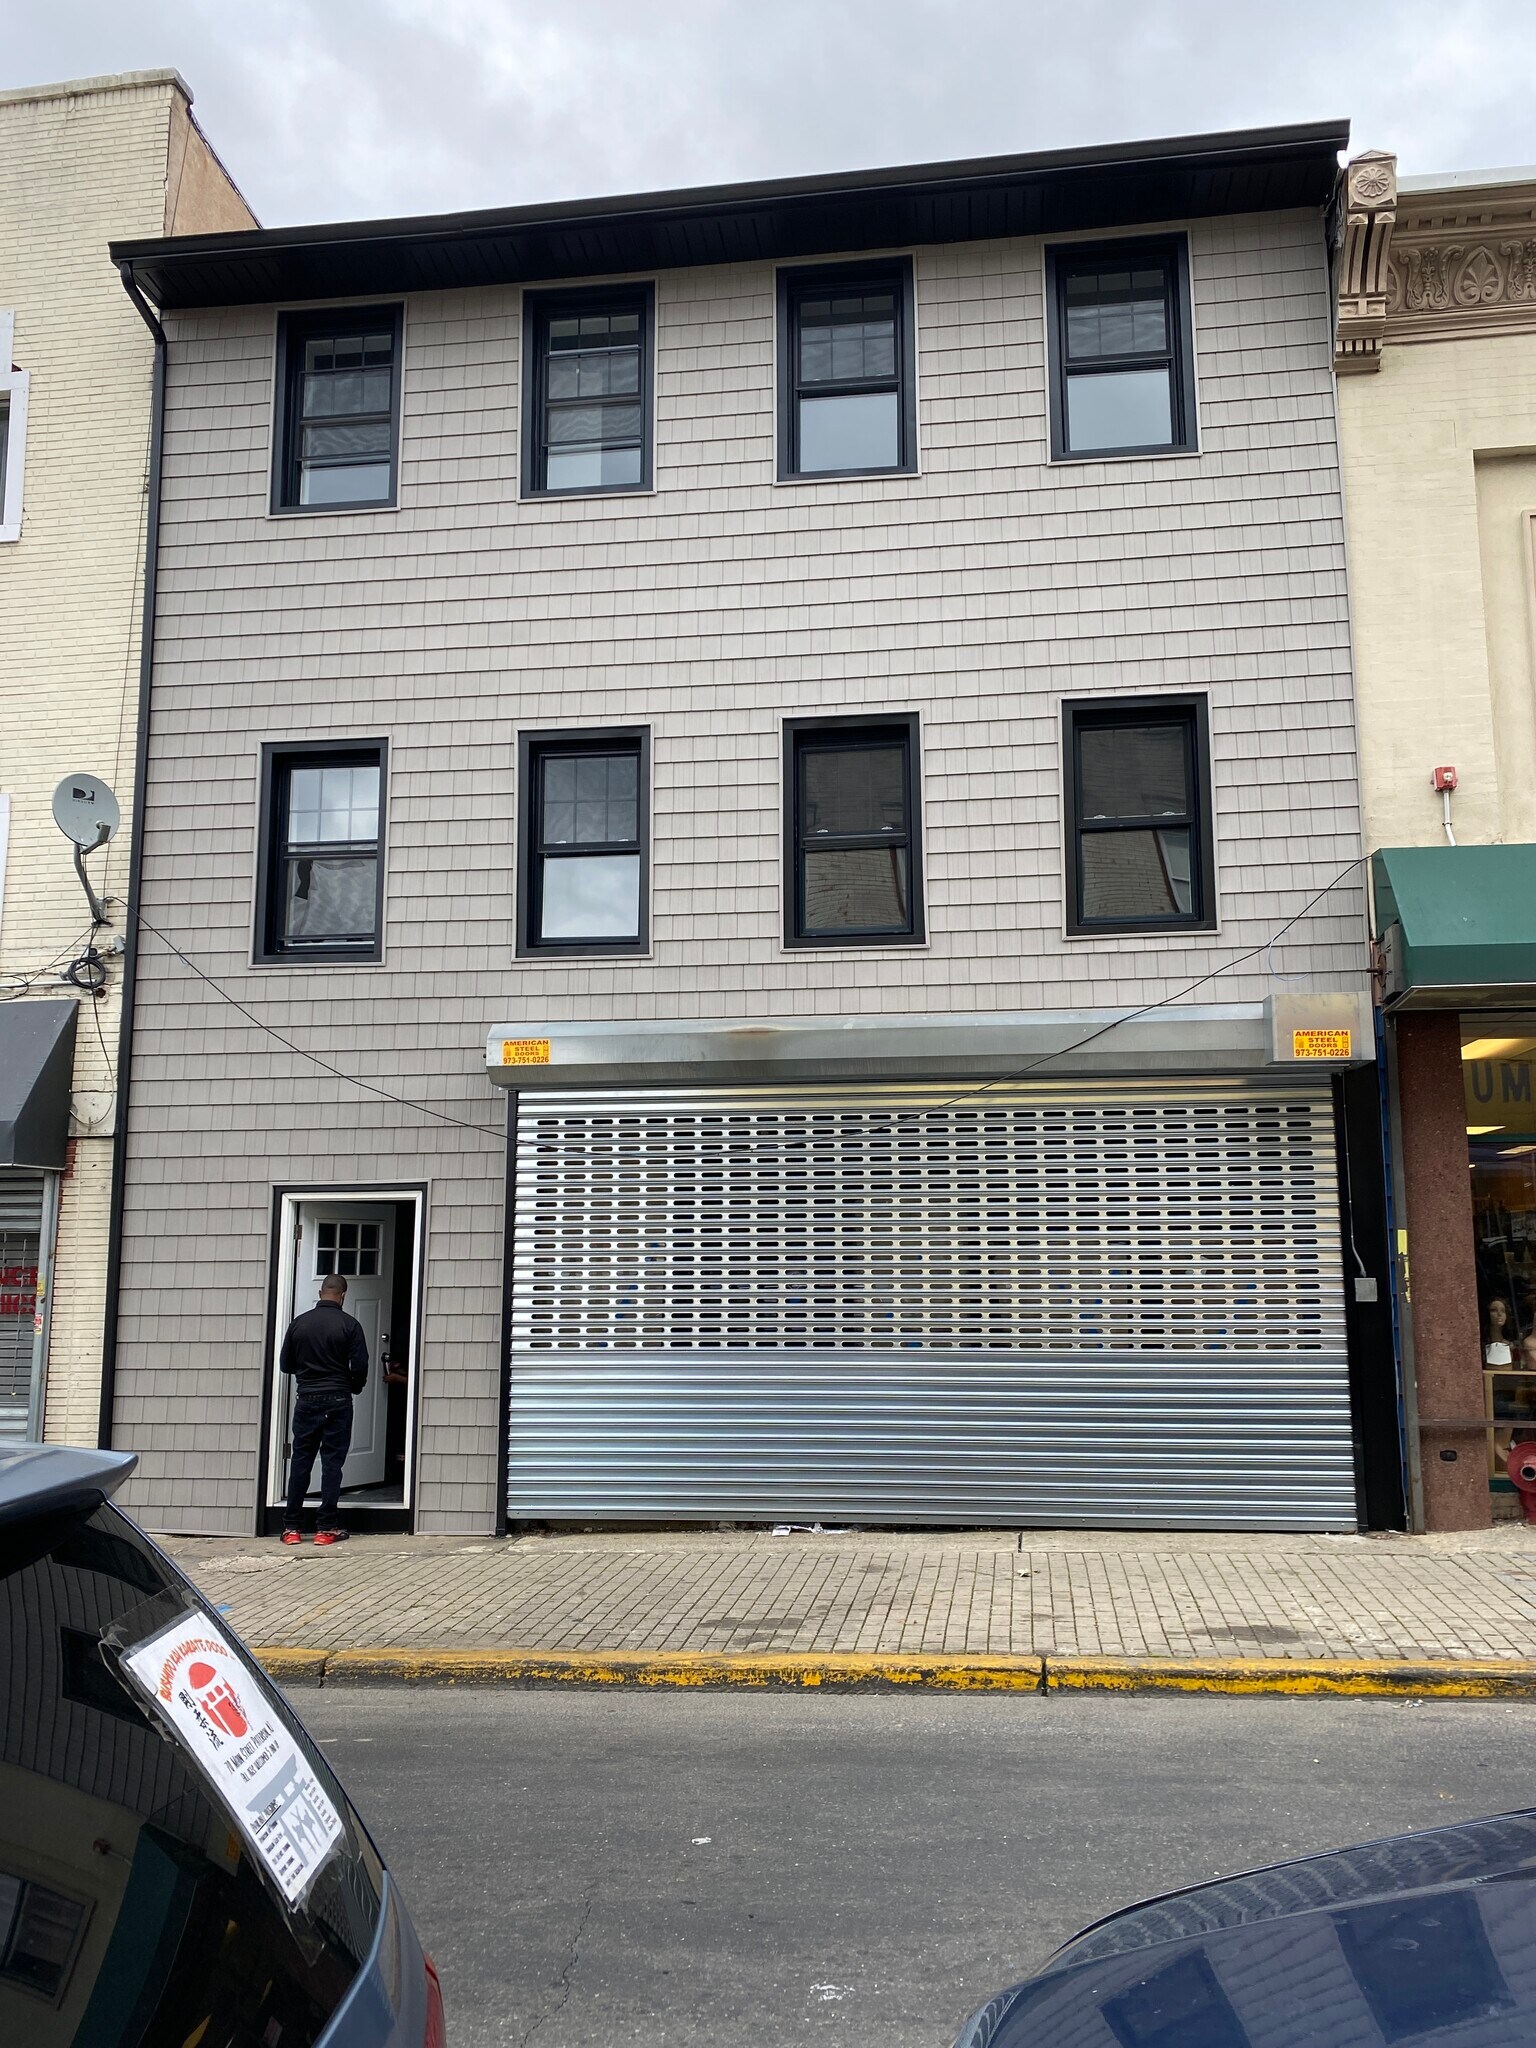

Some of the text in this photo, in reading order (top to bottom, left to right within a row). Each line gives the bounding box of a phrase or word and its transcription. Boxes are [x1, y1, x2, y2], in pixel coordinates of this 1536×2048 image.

[1295, 1049, 1350, 1057] 973-751-0226
[503, 1056, 549, 1064] 973-751-0226
[178, 1639, 207, 1657] KARATE
